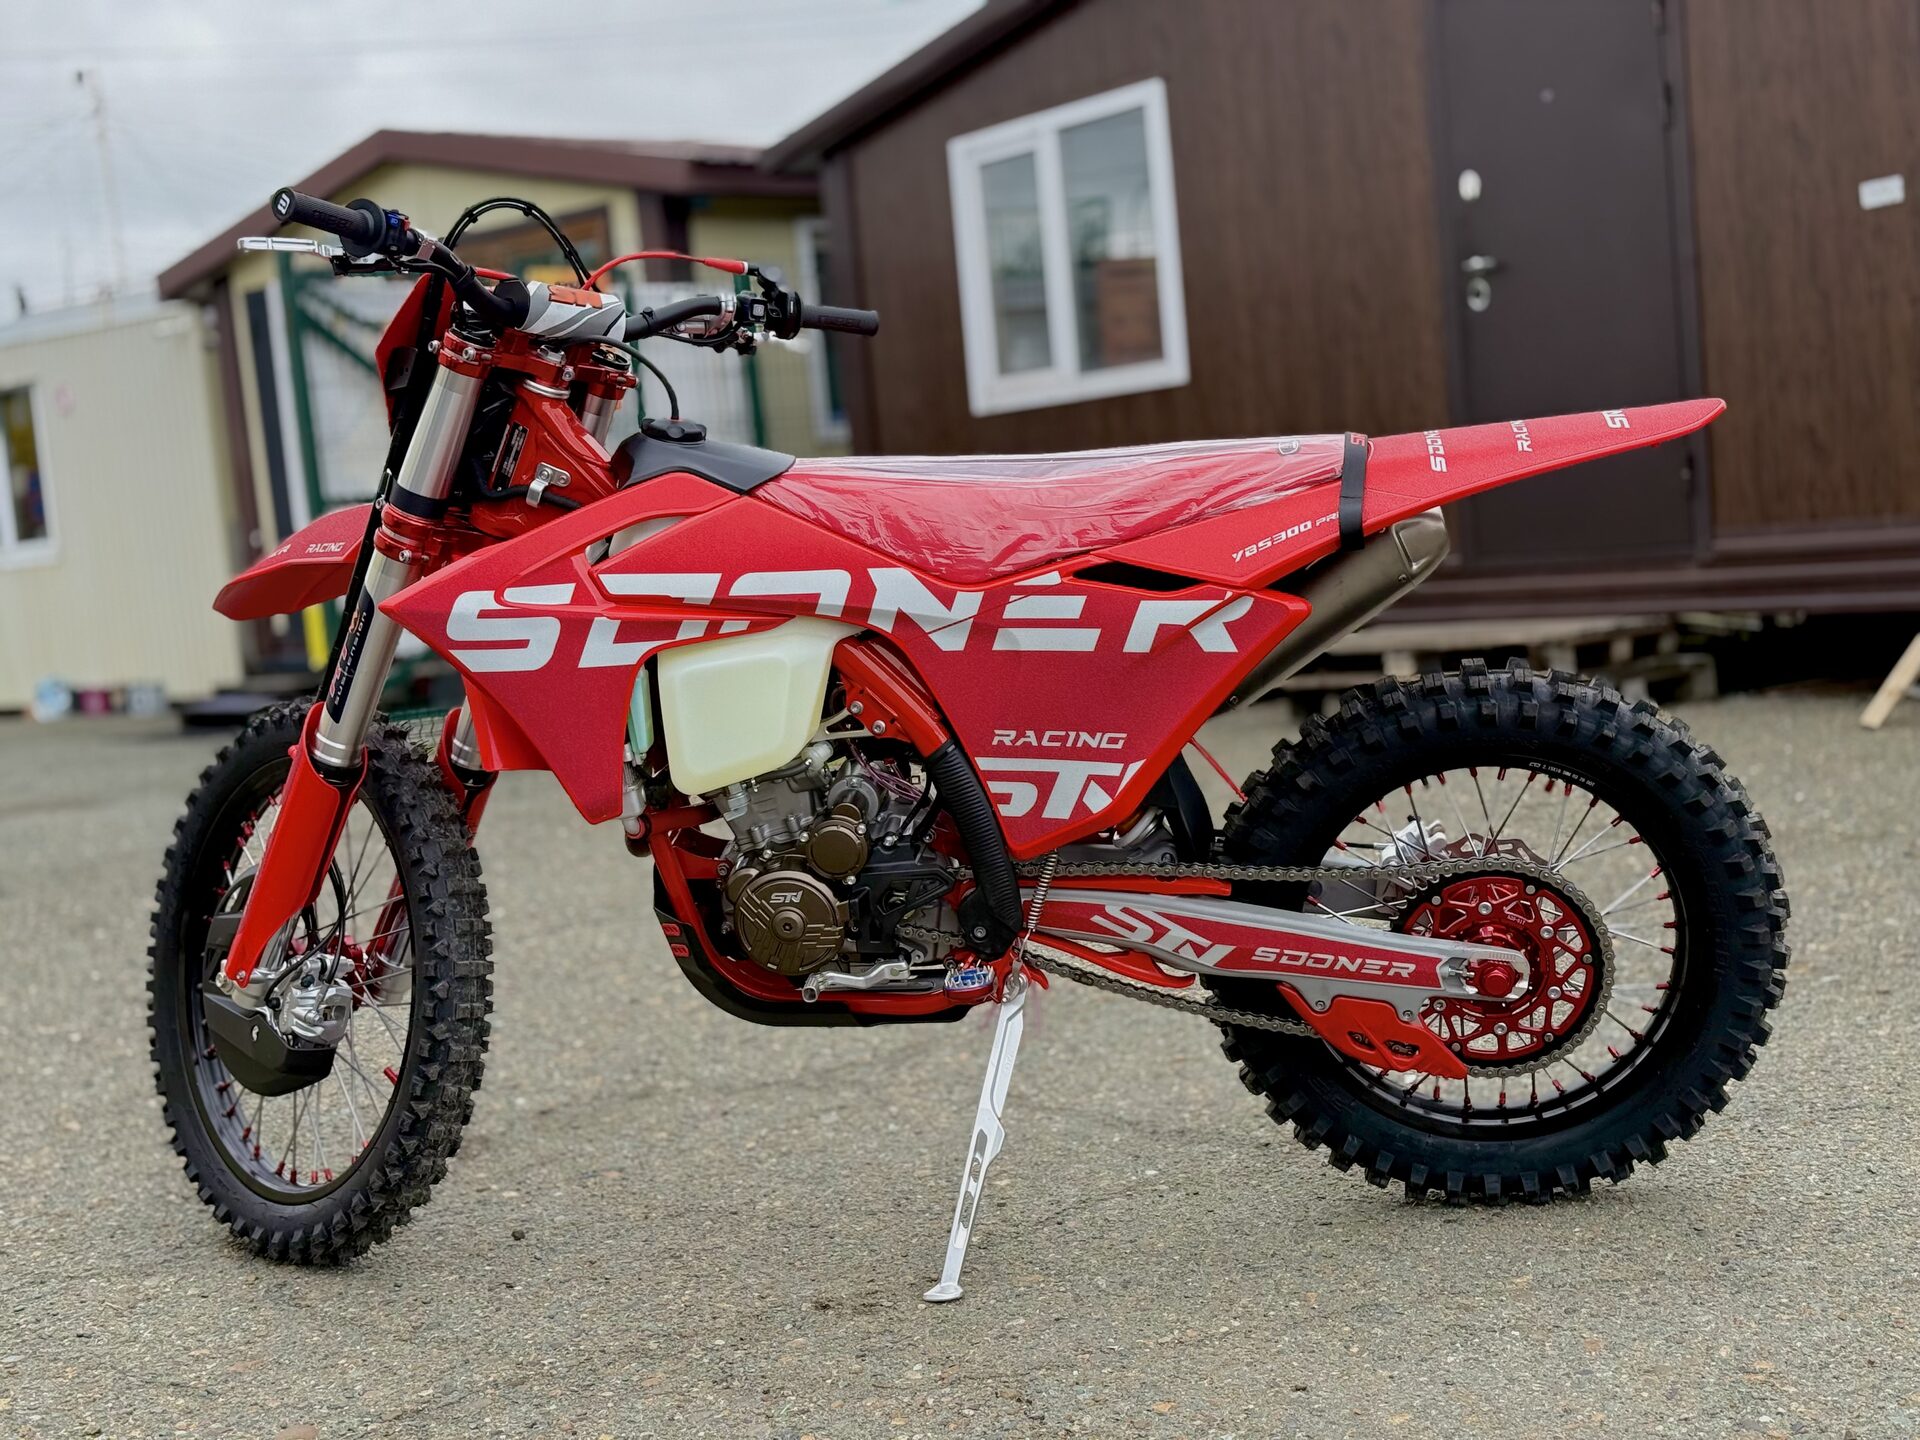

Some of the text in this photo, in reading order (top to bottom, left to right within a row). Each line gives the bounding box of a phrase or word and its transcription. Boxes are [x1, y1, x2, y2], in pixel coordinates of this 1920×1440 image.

[1315, 511, 1340, 528] PR
[305, 541, 346, 554] RACING
[991, 729, 1128, 750] RACING
[1250, 945, 1417, 979] SOONER
